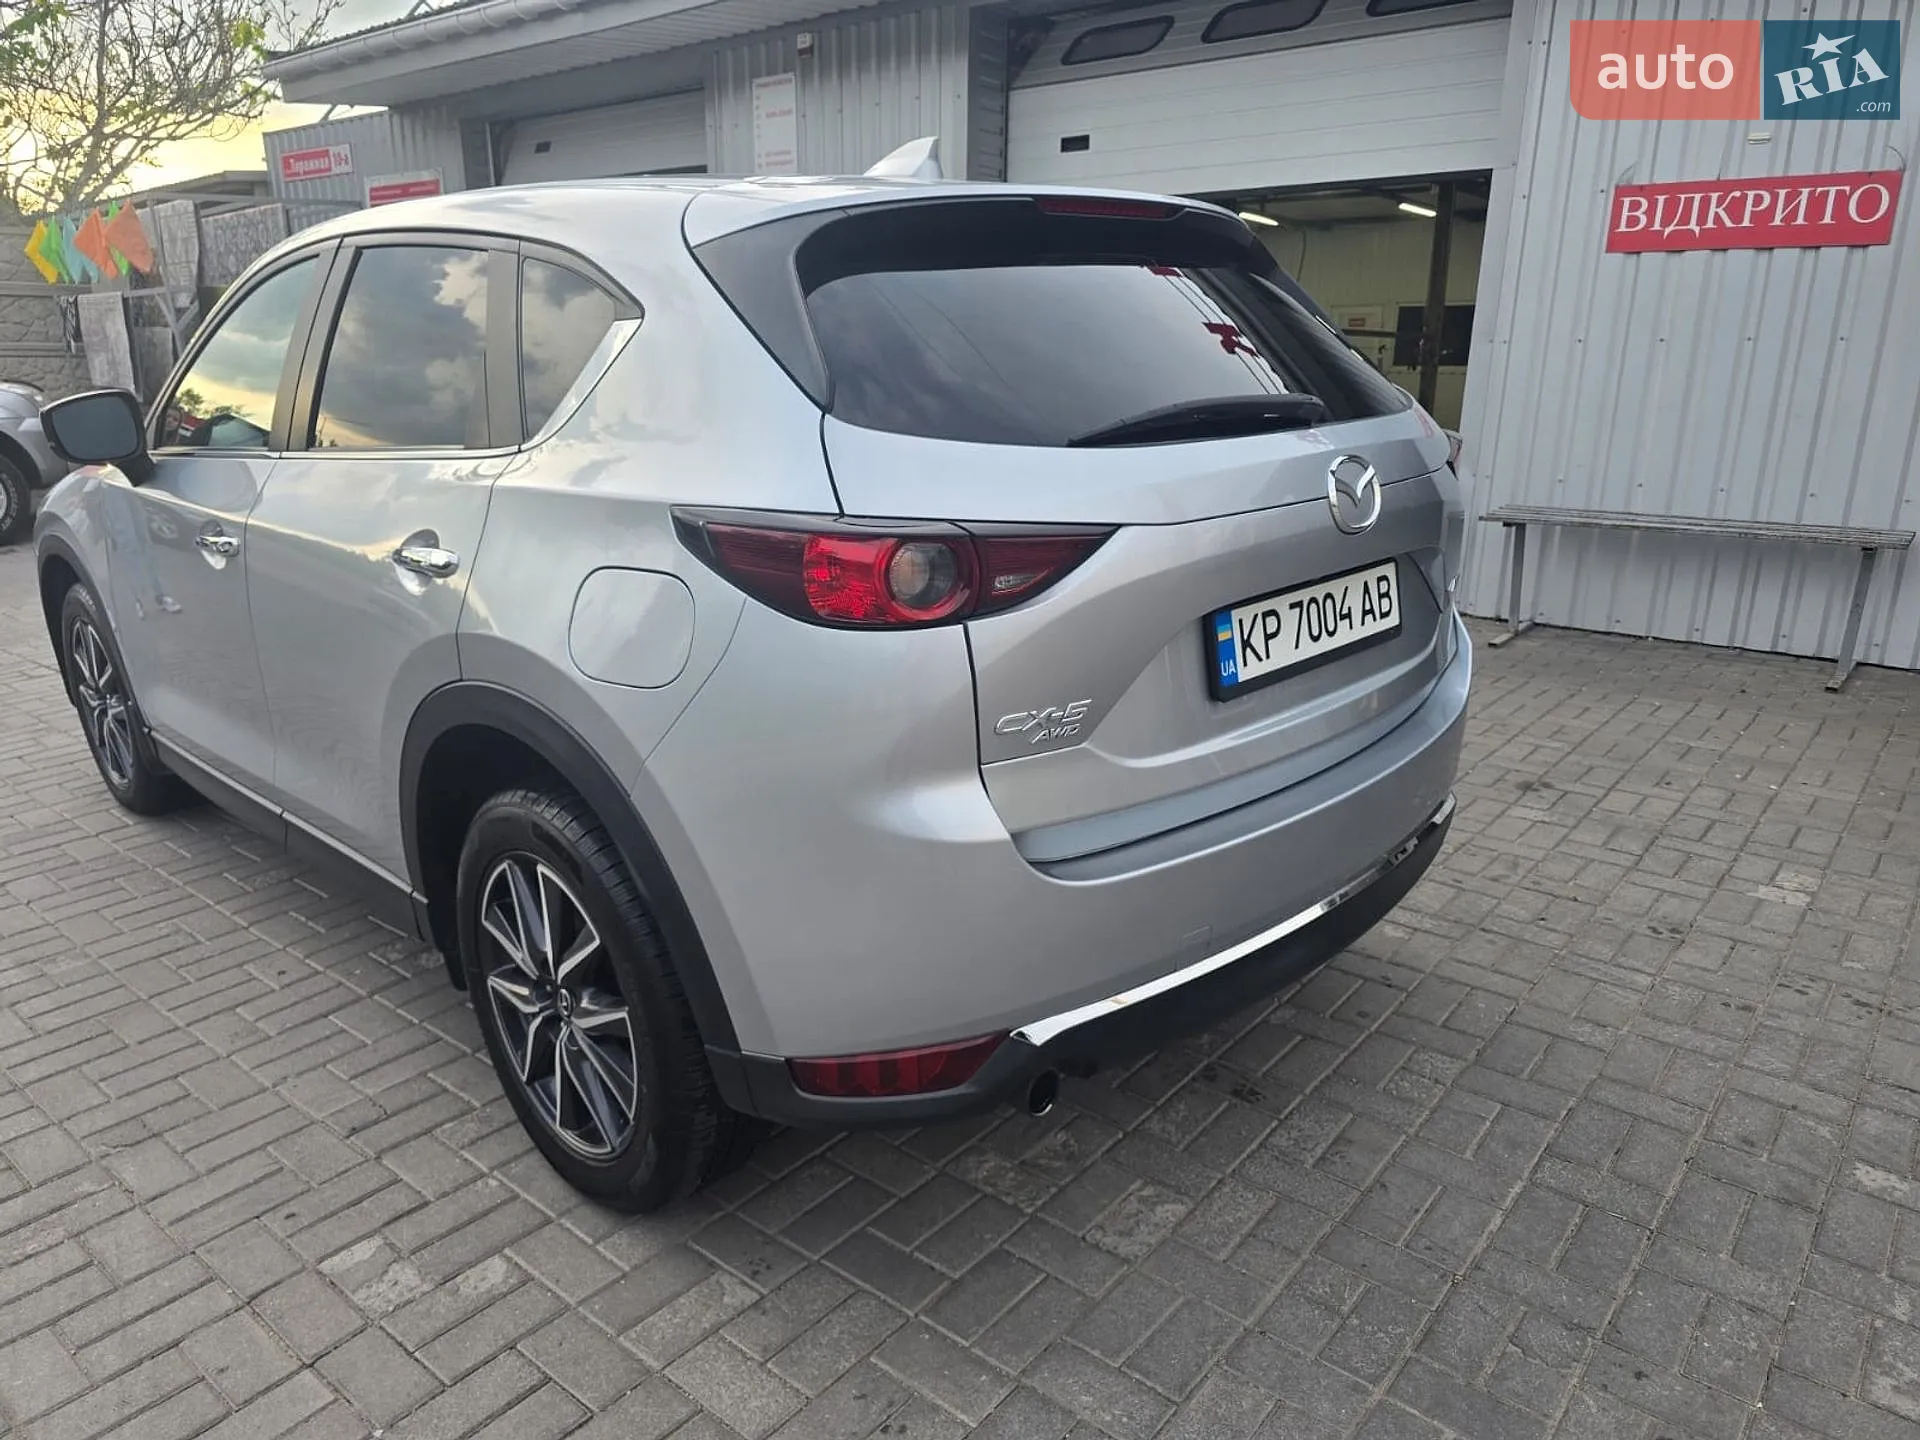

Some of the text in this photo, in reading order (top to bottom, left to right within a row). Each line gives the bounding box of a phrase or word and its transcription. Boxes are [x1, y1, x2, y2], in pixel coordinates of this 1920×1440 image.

[1615, 184, 1891, 239] ВІДКРИТО
[1238, 574, 1393, 667] KP 7004 AB
[1221, 661, 1236, 676] UA
[995, 699, 1093, 735] CX-5
[1030, 723, 1081, 745] AWD
